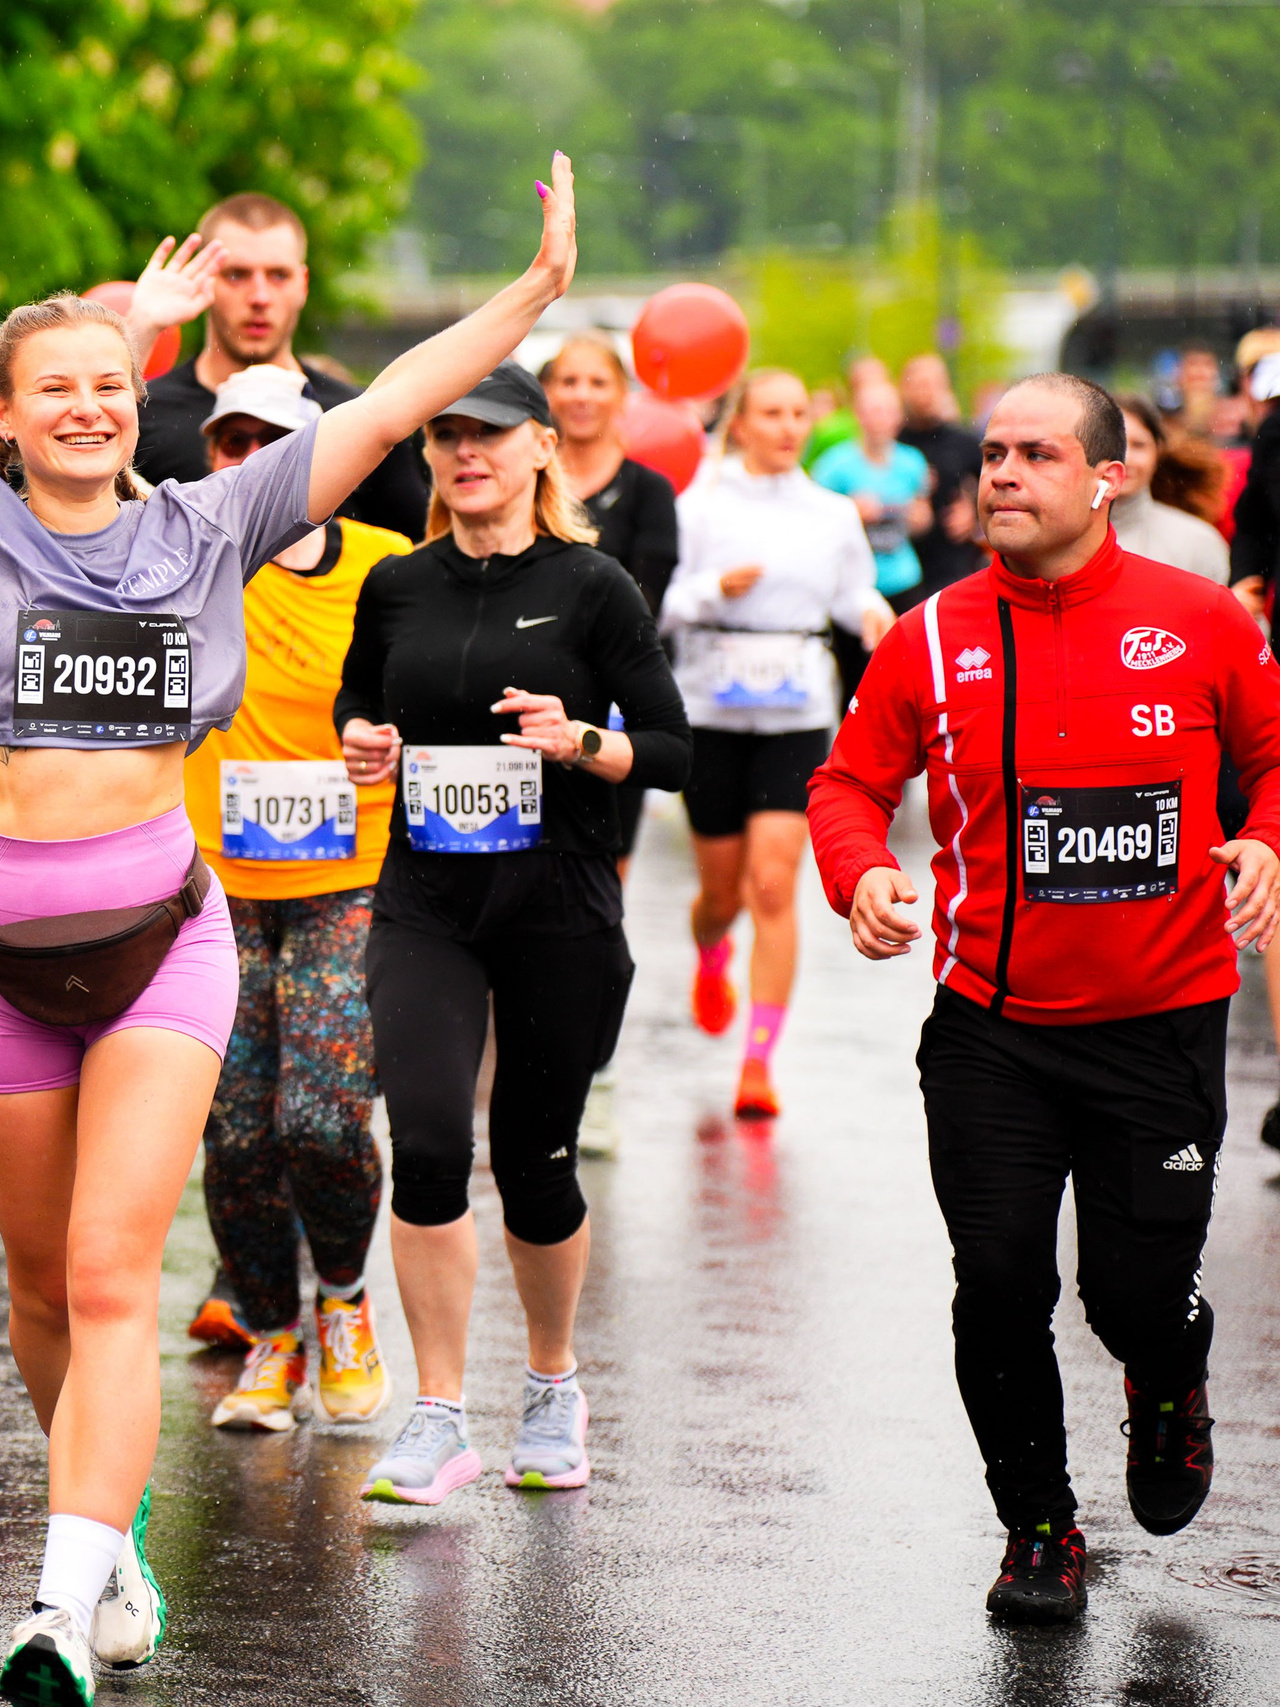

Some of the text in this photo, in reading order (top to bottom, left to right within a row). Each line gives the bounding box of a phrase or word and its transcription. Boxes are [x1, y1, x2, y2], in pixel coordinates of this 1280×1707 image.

[115, 547, 193, 596] TEMPLE
[162, 633, 188, 646] 10 KM
[1125, 630, 1166, 664] TuS
[1137, 651, 1156, 660] 1911
[53, 653, 157, 697] 20932
[1130, 704, 1176, 737] SB
[525, 762, 537, 771] KM
[254, 796, 326, 826] 10731
[432, 784, 510, 815] 10053
[1155, 797, 1178, 812] 10 KM
[1057, 823, 1152, 864] 20469
[1163, 1160, 1205, 1171] adida
